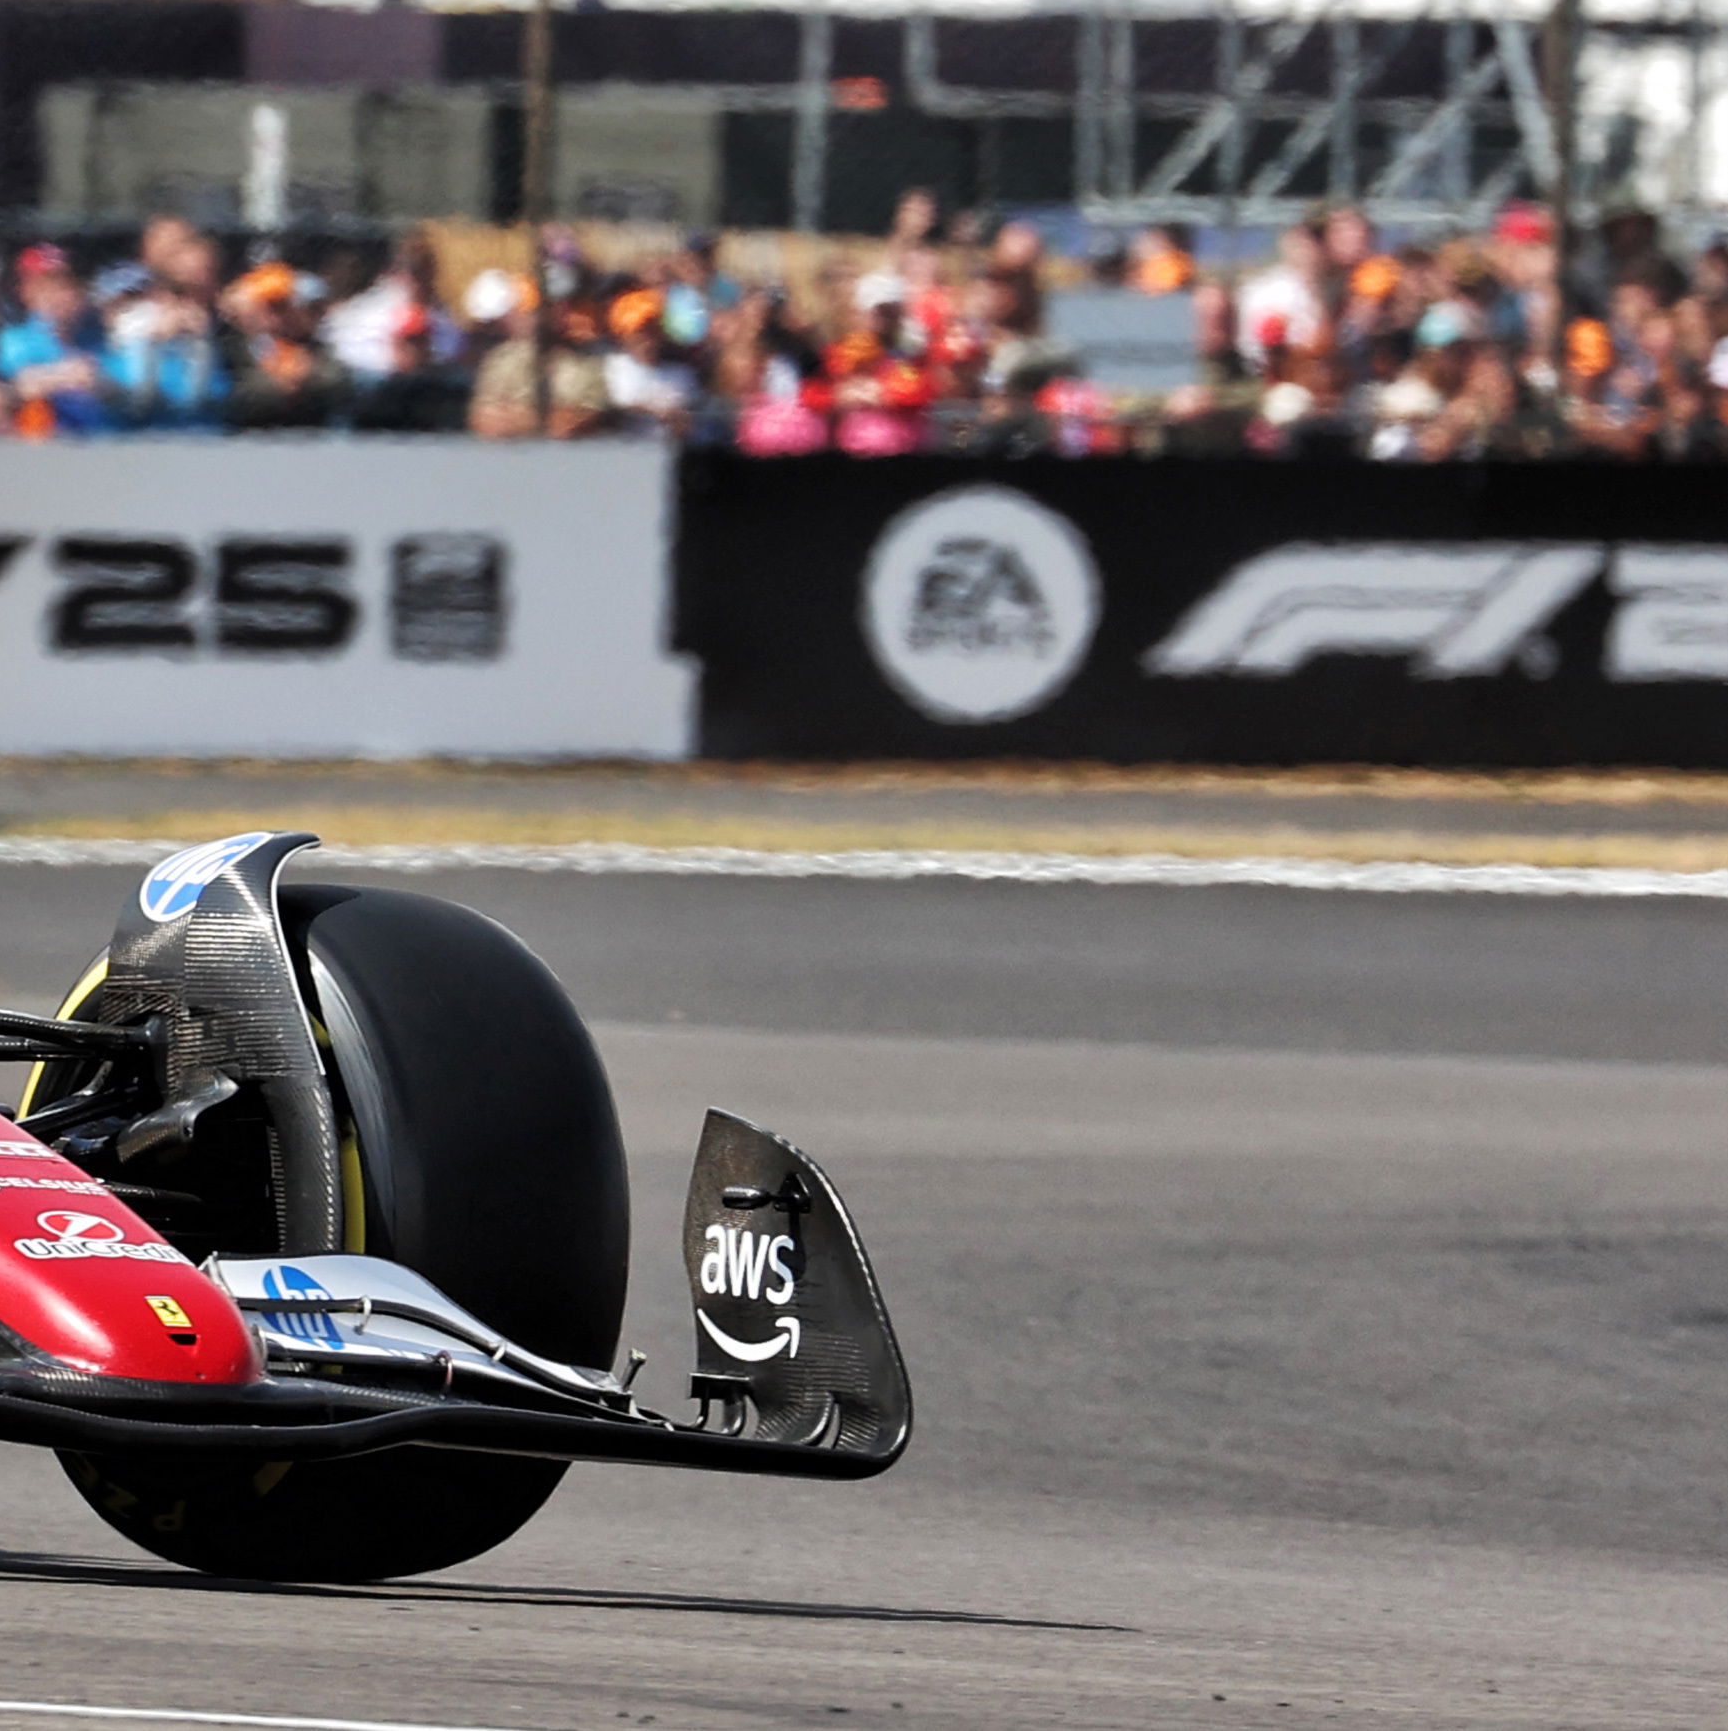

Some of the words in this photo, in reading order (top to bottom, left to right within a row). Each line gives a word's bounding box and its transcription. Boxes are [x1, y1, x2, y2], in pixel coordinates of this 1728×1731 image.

[49, 534, 358, 657] 25
[13, 1236, 195, 1267] UniCredit
[698, 1224, 797, 1303] aws
